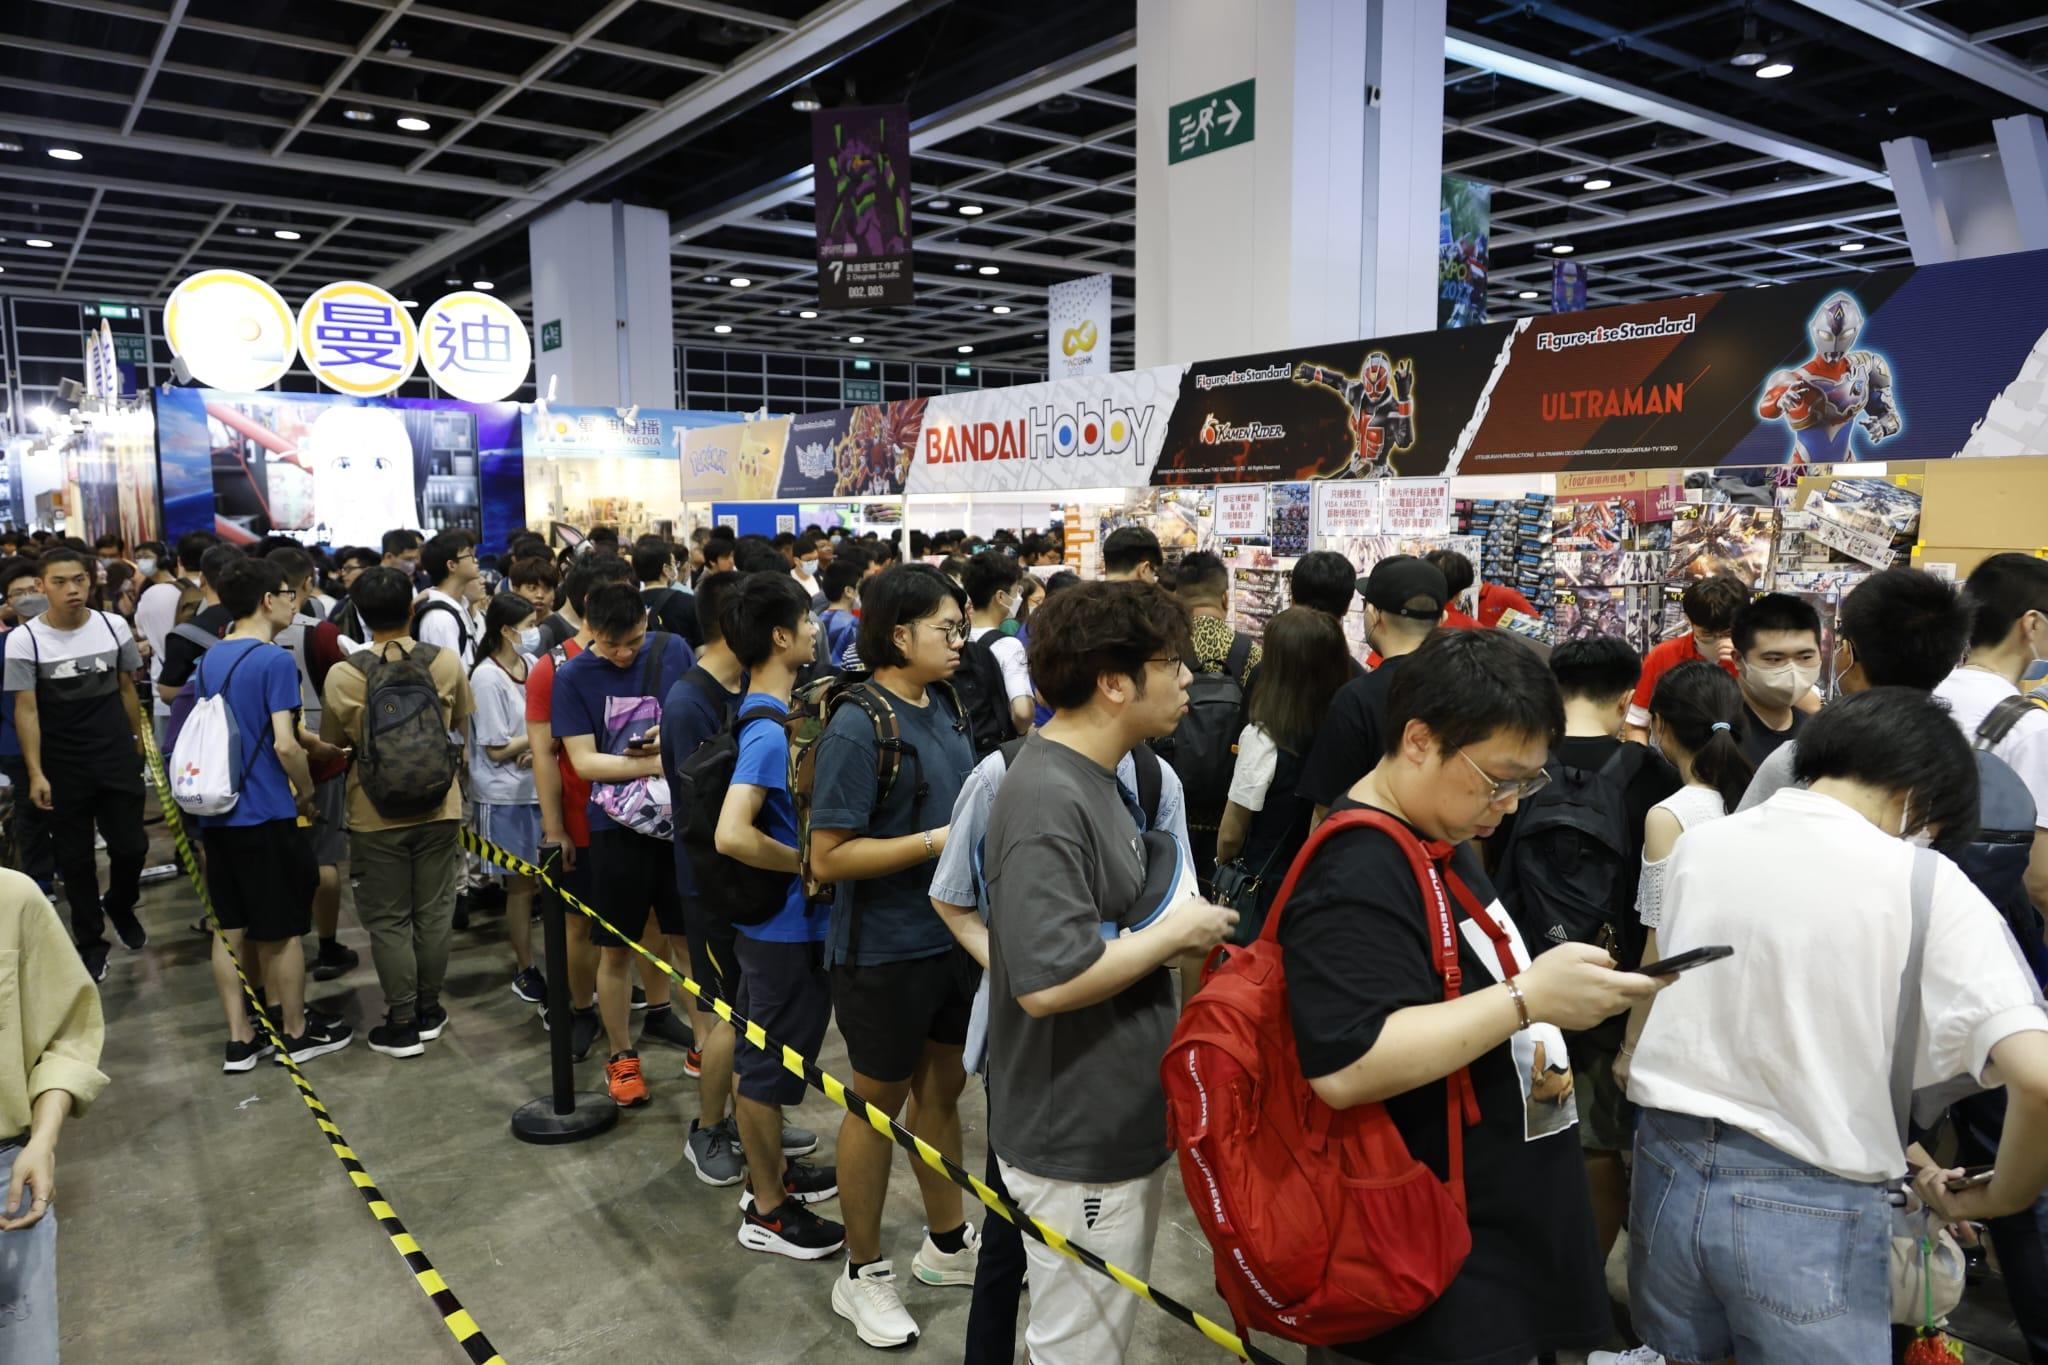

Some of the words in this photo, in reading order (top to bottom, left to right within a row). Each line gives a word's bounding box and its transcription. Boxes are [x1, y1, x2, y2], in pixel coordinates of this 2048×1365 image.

[1620, 313, 1696, 339] Standard
[1246, 362, 1292, 381] Standard
[1541, 383, 1684, 421] ULTRAMAN
[626, 436, 661, 446] MEDIA
[926, 418, 1026, 465] BANDAI
[1029, 398, 1156, 466] Hobby
[1428, 867, 1452, 948] SUPREME
[1189, 1049, 1207, 1127] SUPREME
[1190, 1147, 1225, 1224] SUPREME
